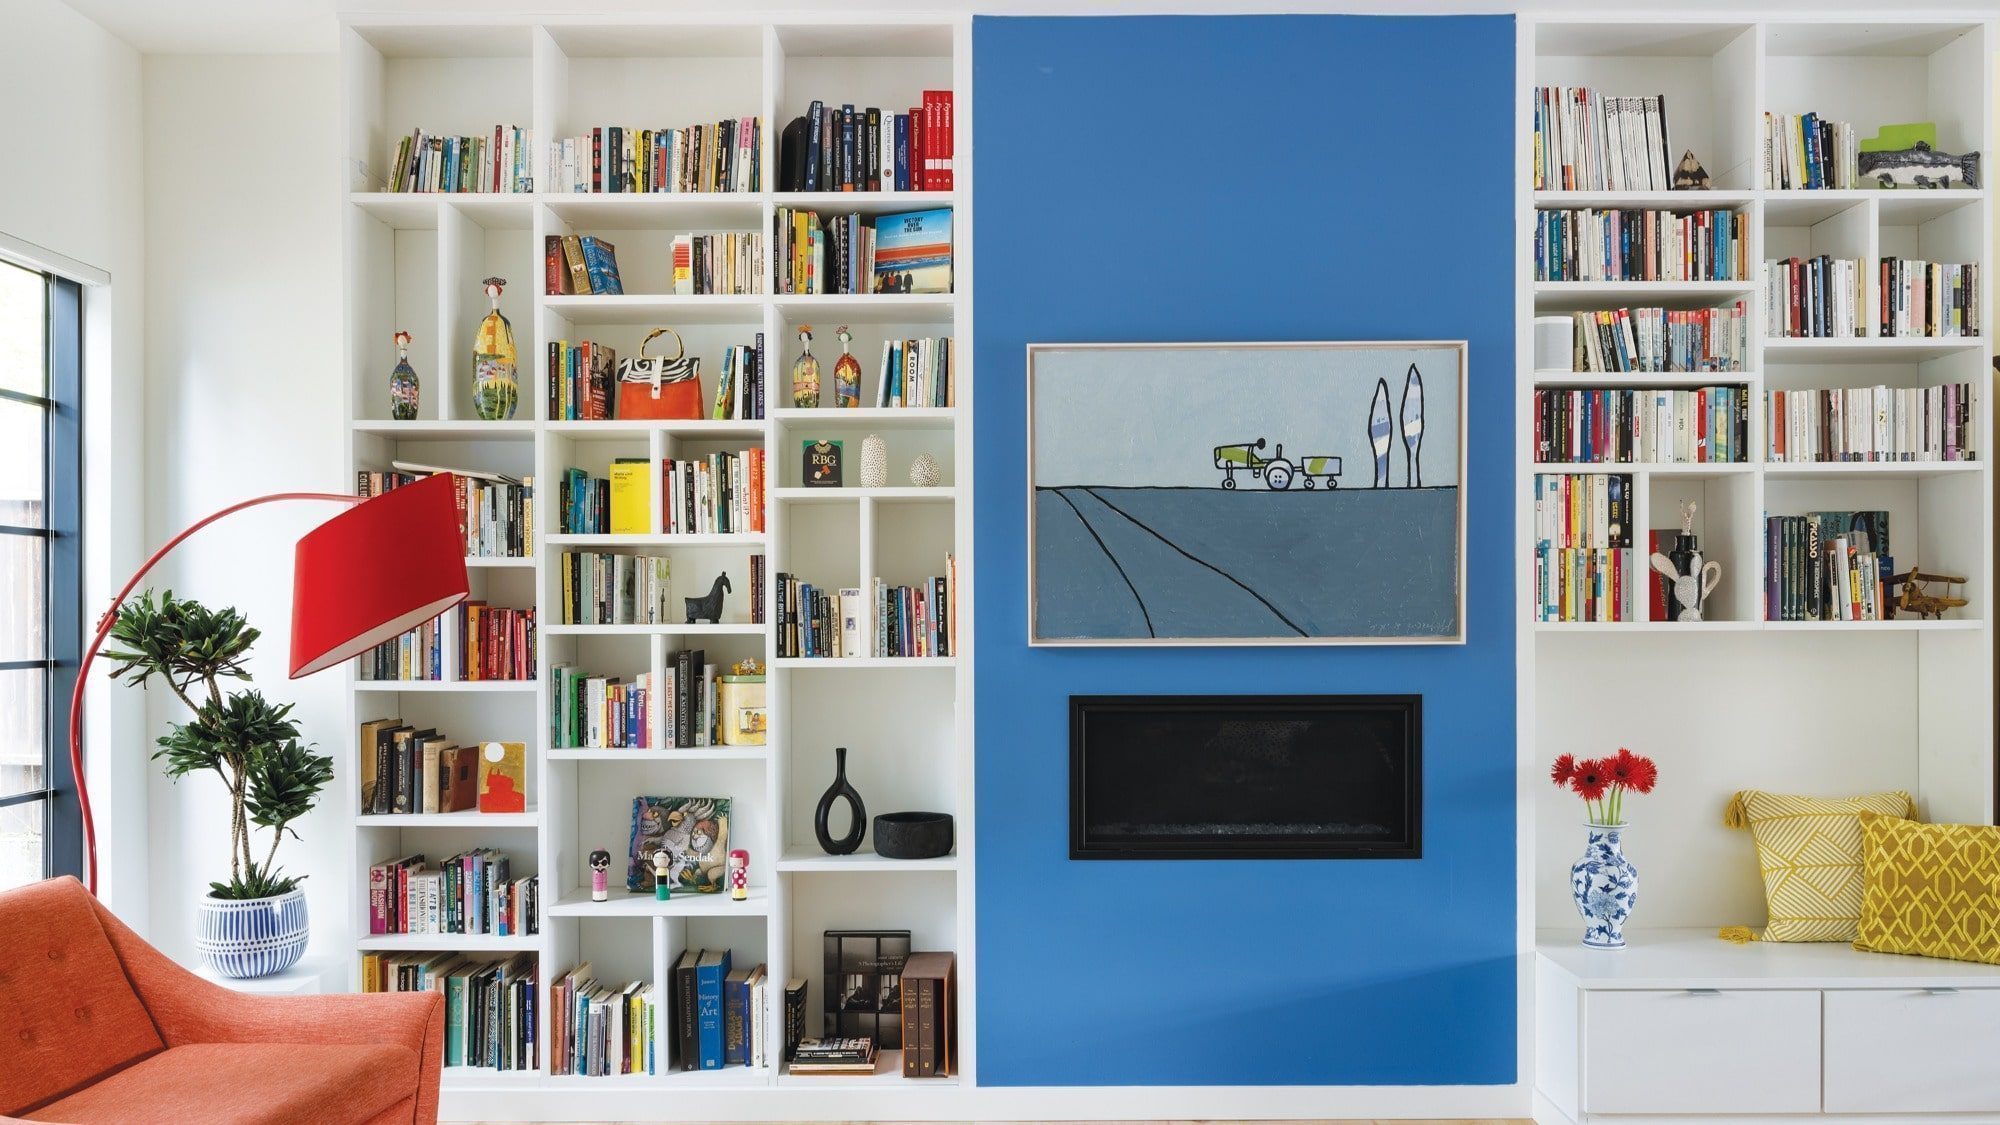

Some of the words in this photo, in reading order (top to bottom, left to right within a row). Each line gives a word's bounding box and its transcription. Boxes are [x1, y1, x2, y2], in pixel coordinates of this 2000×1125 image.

[812, 455, 836, 464] RBG
[667, 700, 672, 709] WE
[667, 729, 672, 739] DO
[679, 852, 714, 862] Sendak
[701, 1007, 718, 1016] Art
